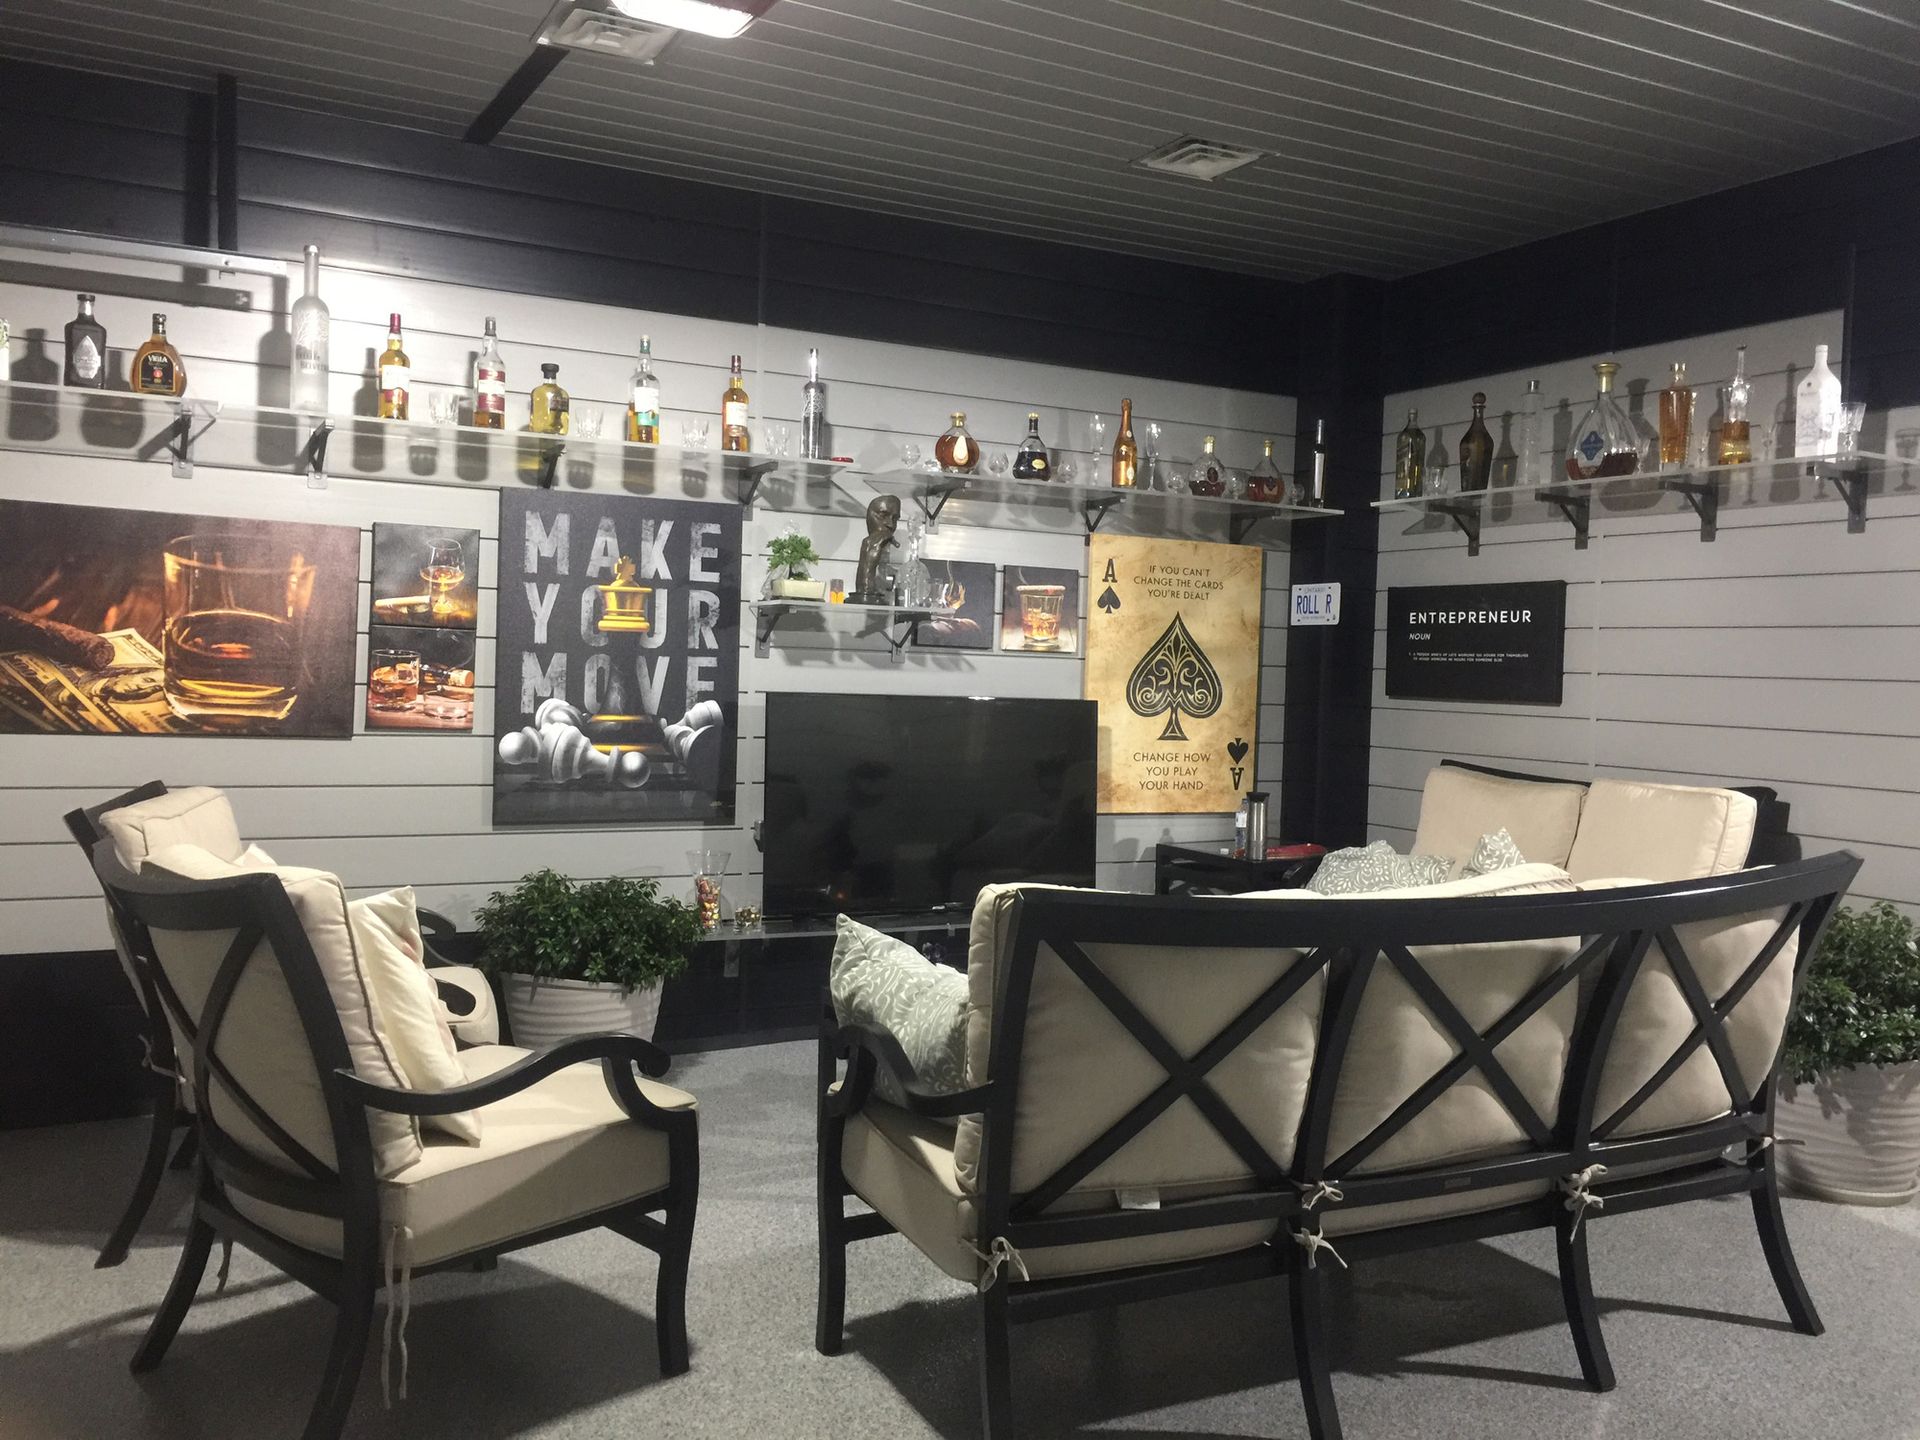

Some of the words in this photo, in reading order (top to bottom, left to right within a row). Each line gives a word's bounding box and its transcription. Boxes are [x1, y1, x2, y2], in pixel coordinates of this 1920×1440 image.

[524, 510, 722, 583] MAKE
[1102, 558, 1118, 583] A
[1149, 565, 1156, 574] IF
[1160, 566, 1180, 575] YOU
[1182, 567, 1210, 577] CAN'T
[1133, 576, 1173, 587] CHANGE
[1176, 578, 1191, 588] THE
[1194, 580, 1224, 590] CARDS
[1147, 588, 1180, 599] YOU'RE
[1183, 590, 1210, 600] DEALT
[1296, 594, 1320, 615] ROLL
[523, 582, 720, 649] YOUR
[1409, 610, 1532, 624] ENTREPRENEUR
[1408, 633, 1431, 641] NOUN
[521, 652, 718, 715] MOVE
[1133, 752, 1179, 762] CHANGE
[1183, 753, 1212, 763] HOW
[1146, 766, 1170, 776] YOU
[1173, 767, 1198, 776] PLAY
[1139, 780, 1169, 791] YOUR
[1172, 780, 1204, 791] HAND
